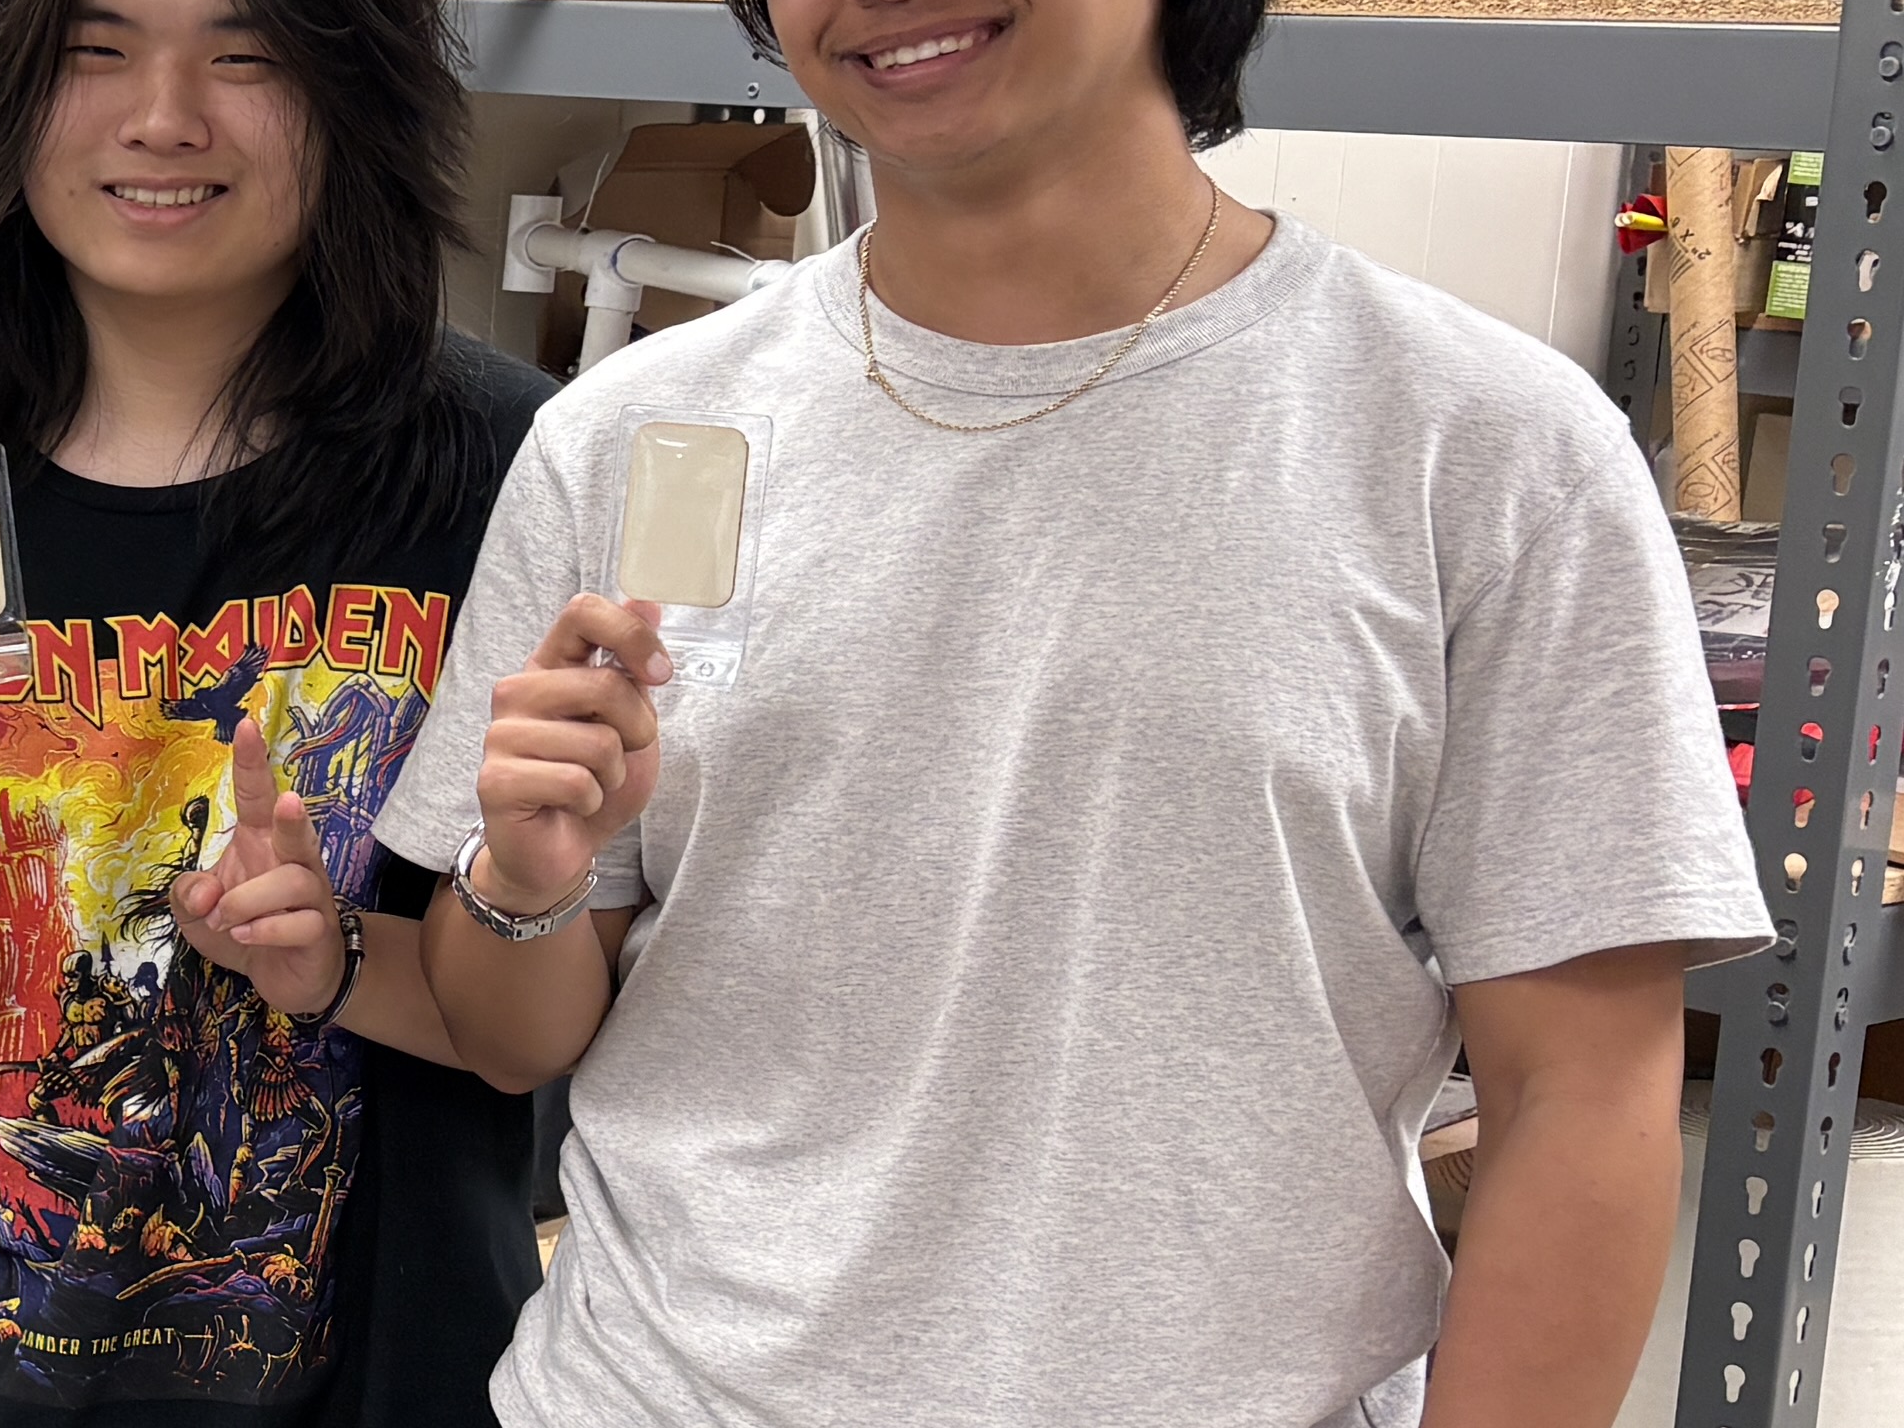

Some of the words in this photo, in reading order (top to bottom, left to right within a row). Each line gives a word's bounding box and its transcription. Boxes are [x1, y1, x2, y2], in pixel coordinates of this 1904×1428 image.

[102, 582, 451, 704] MAIDEN
[91, 1335, 119, 1355] THE
[123, 1327, 175, 1349] GREAT
